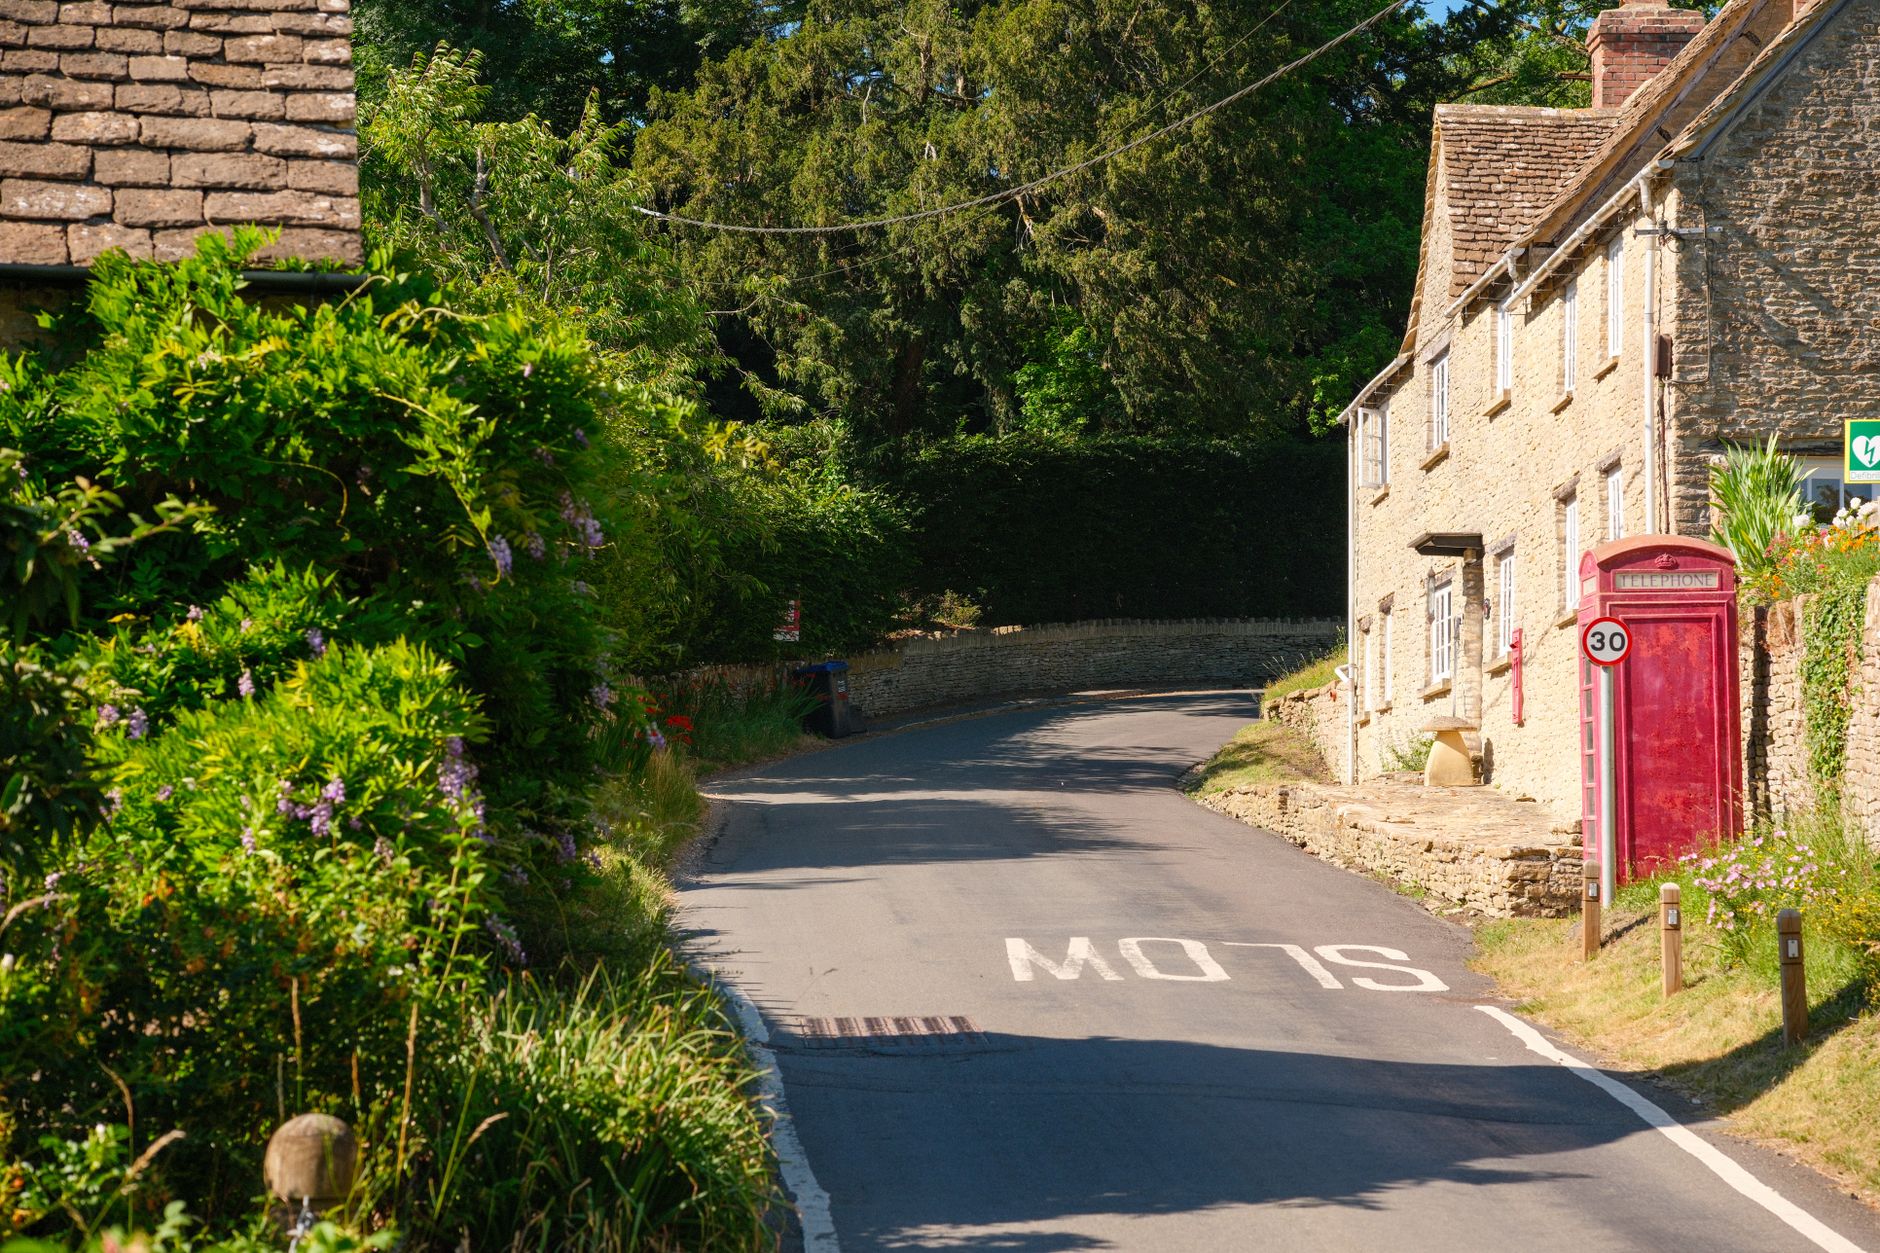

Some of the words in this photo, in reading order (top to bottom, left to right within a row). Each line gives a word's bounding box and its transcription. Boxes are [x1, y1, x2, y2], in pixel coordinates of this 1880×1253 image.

[1620, 573, 1713, 587] TELEPHONE
[1590, 631, 1626, 651] 30
[1004, 936, 1450, 992] SLOW
